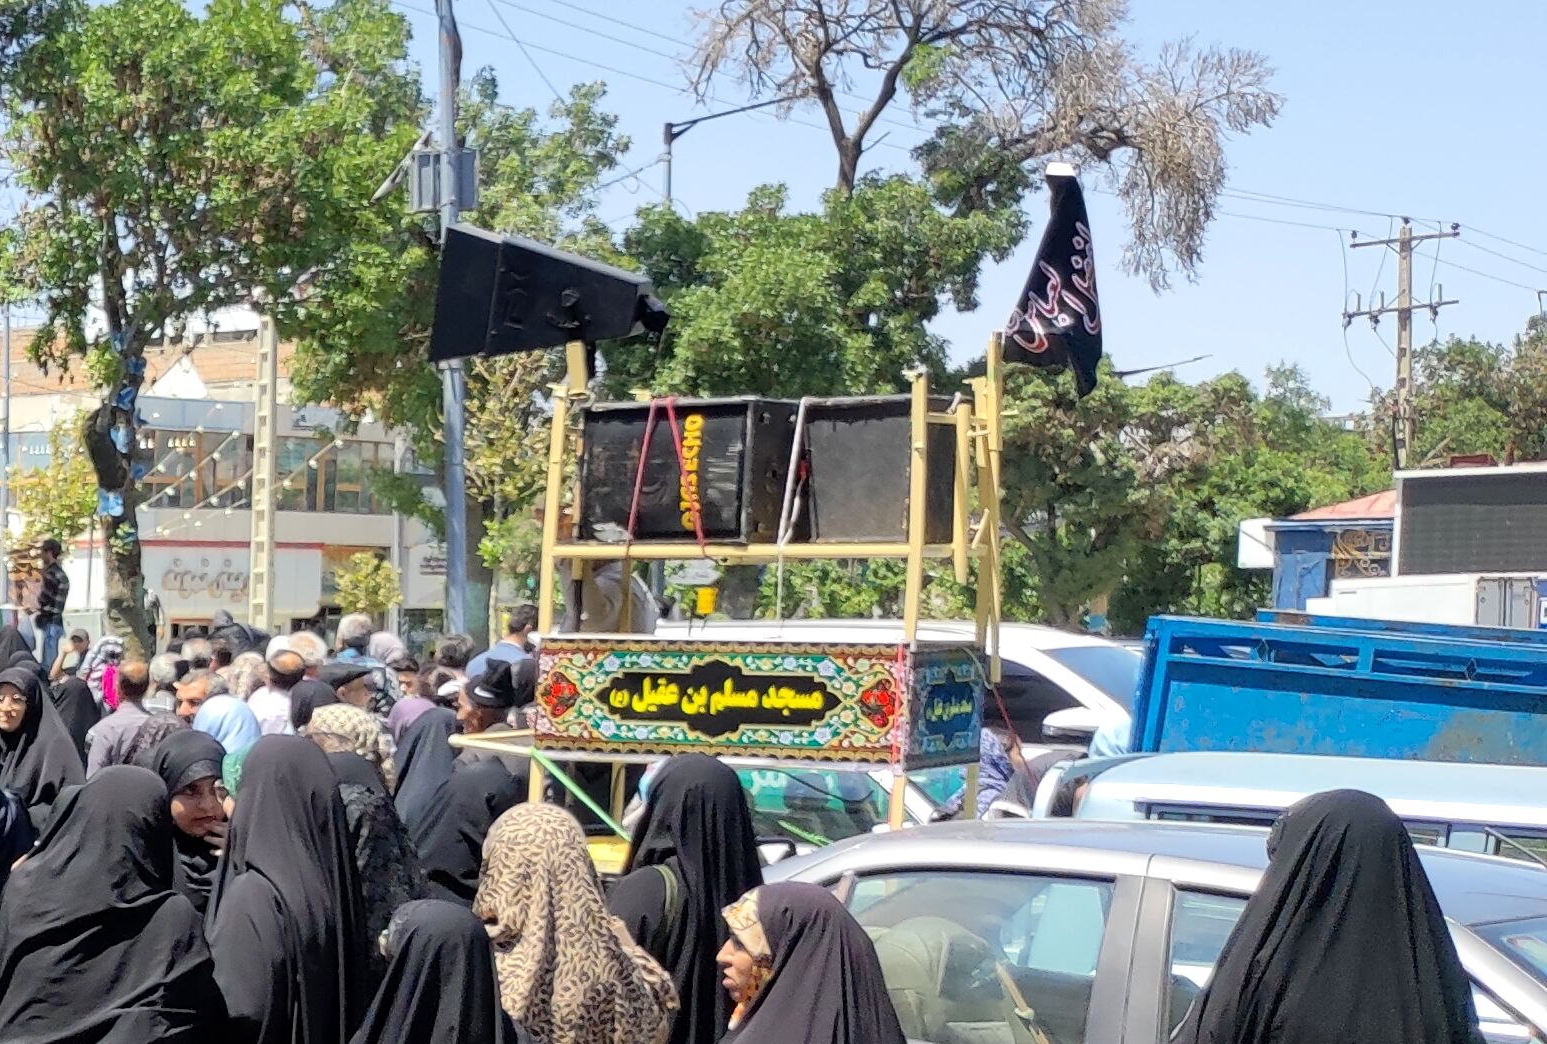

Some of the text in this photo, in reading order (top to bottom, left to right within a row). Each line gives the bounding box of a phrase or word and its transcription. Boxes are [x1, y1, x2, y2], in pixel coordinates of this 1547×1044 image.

[631, 676, 680, 712] عقیل
[680, 684, 709, 715] بن
[709, 676, 759, 716] مسلم
[761, 683, 825, 717] مسجد
